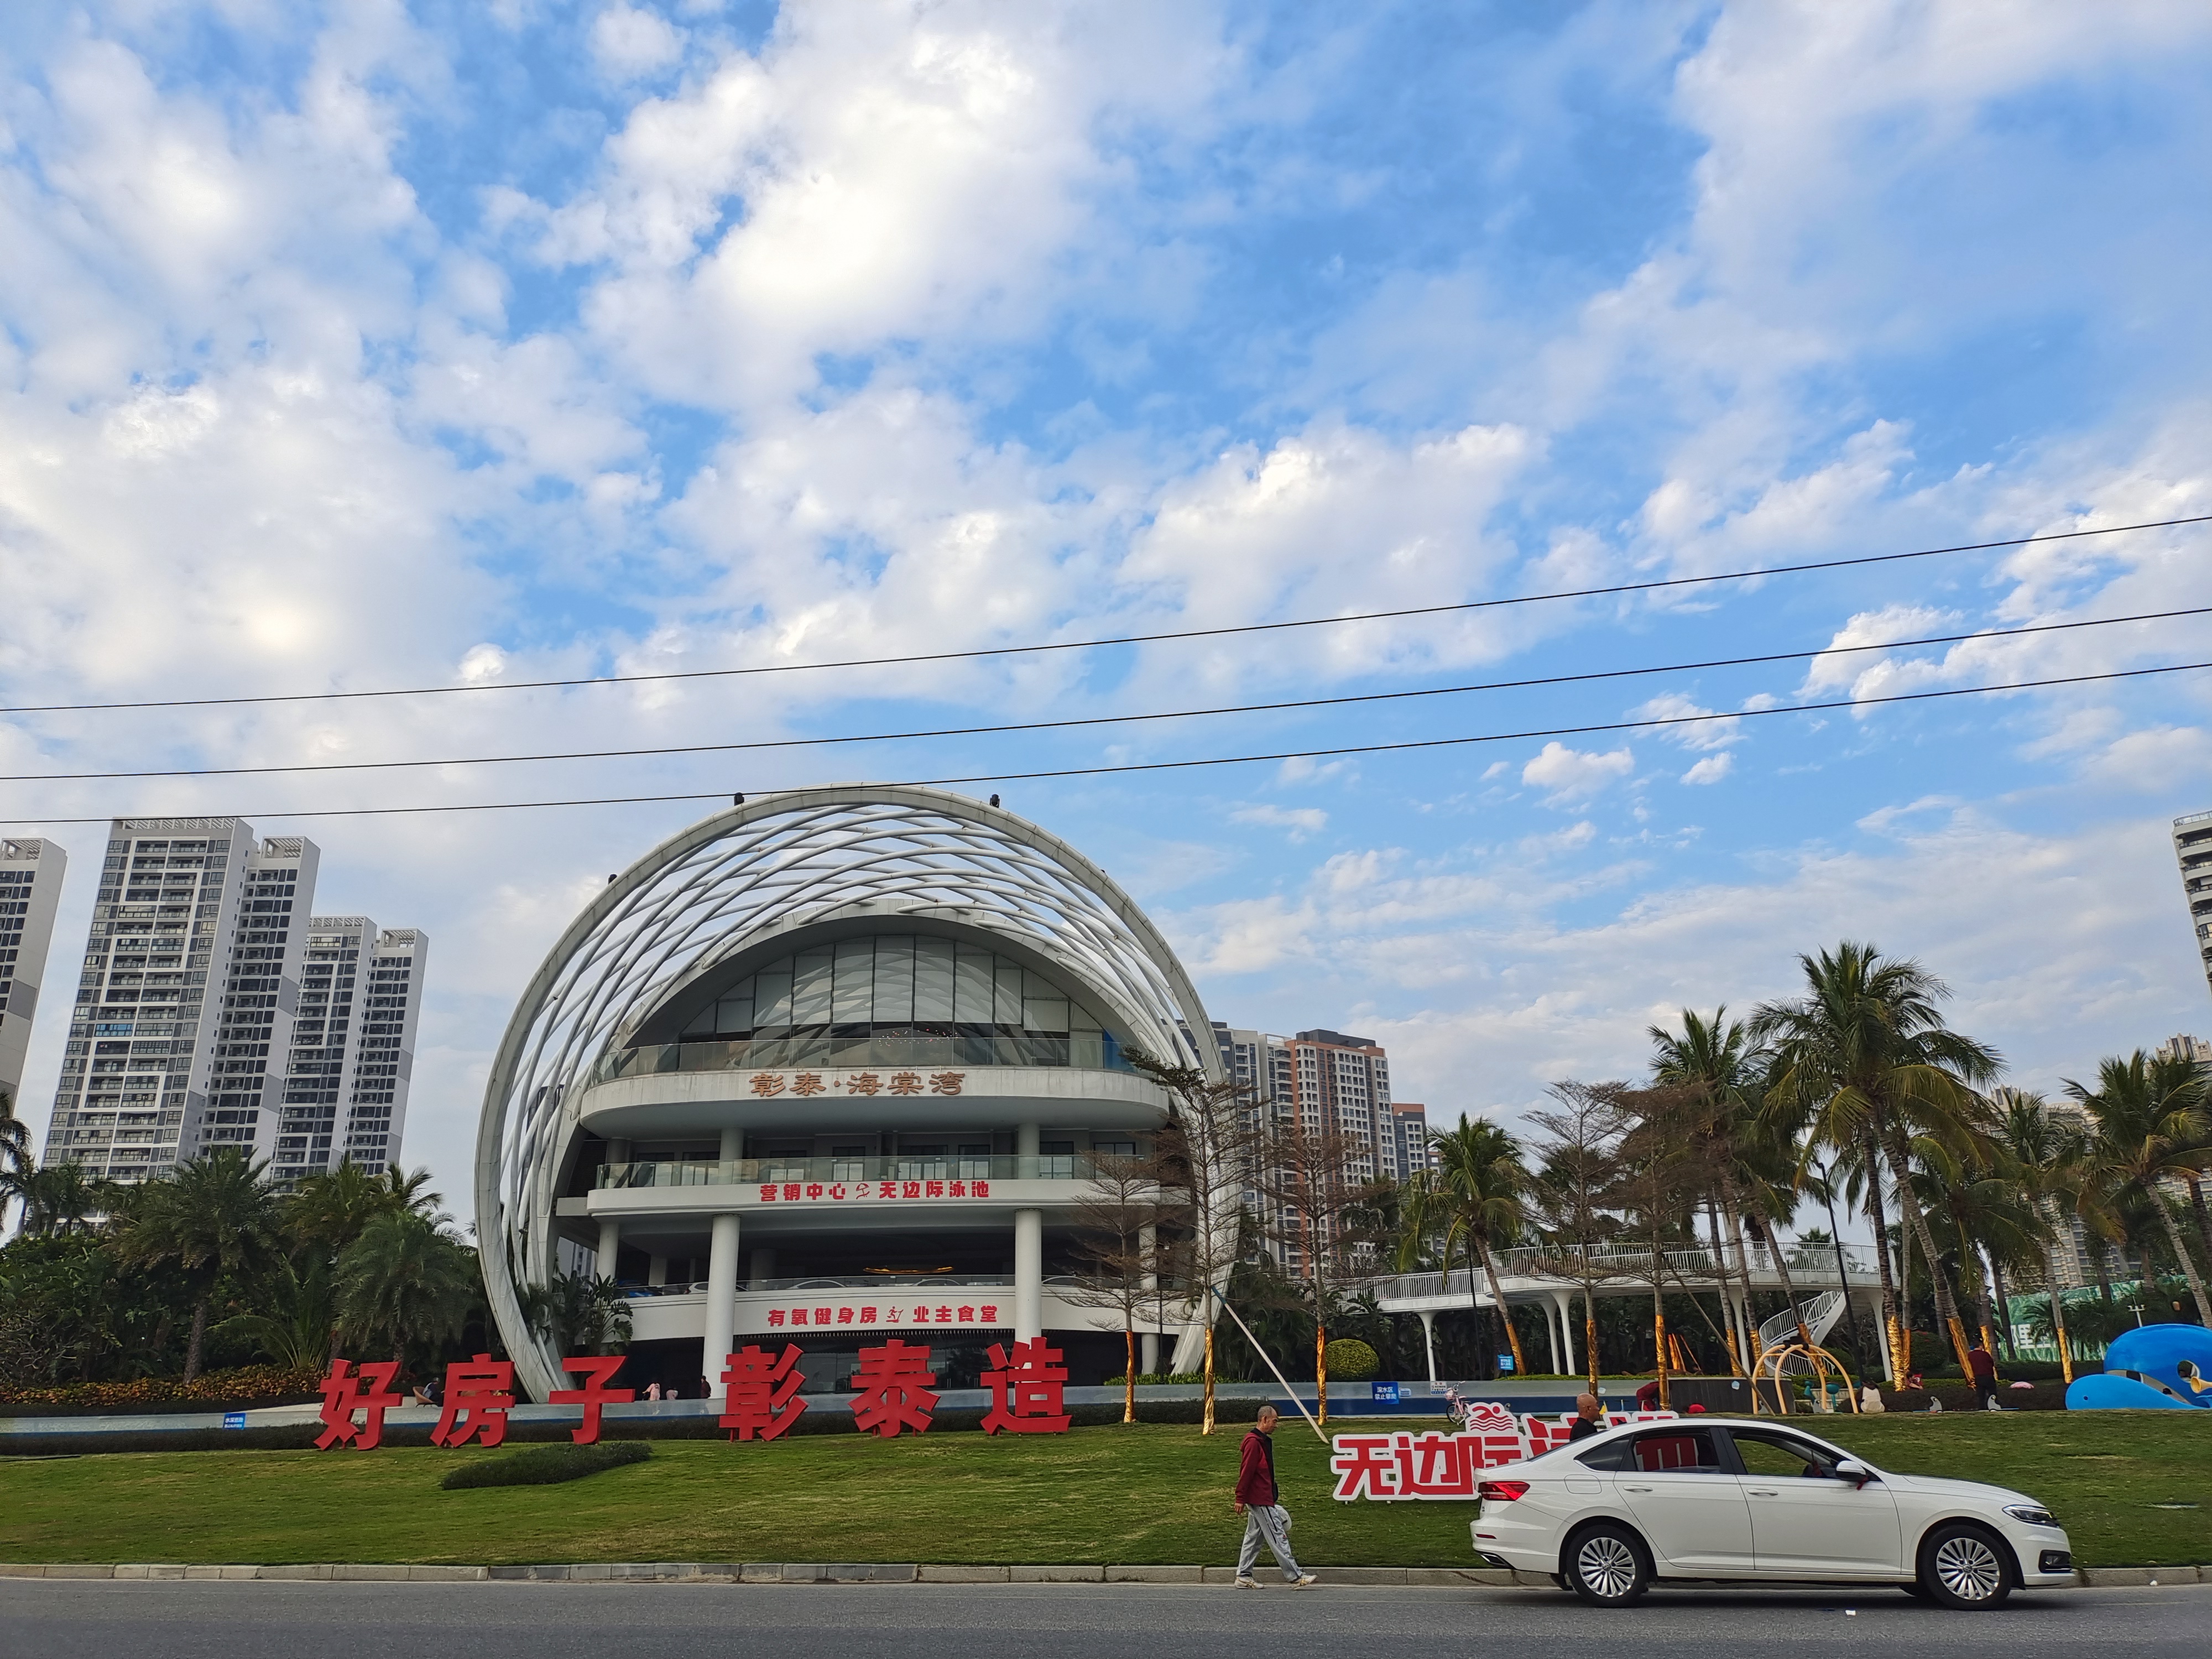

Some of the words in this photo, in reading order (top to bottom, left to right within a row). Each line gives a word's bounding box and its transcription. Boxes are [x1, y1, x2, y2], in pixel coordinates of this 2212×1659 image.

[749, 1072, 965, 1096] 彰泰·海棠湾
[760, 1183, 846, 1202] 营销中心
[879, 1181, 989, 1198] 无边际泳池
[768, 1306, 878, 1327] 有氧健身房
[913, 1306, 998, 1322] 业主食堂
[314, 1353, 635, 1451] 好房子
[719, 1337, 1072, 1441] 彰泰造
